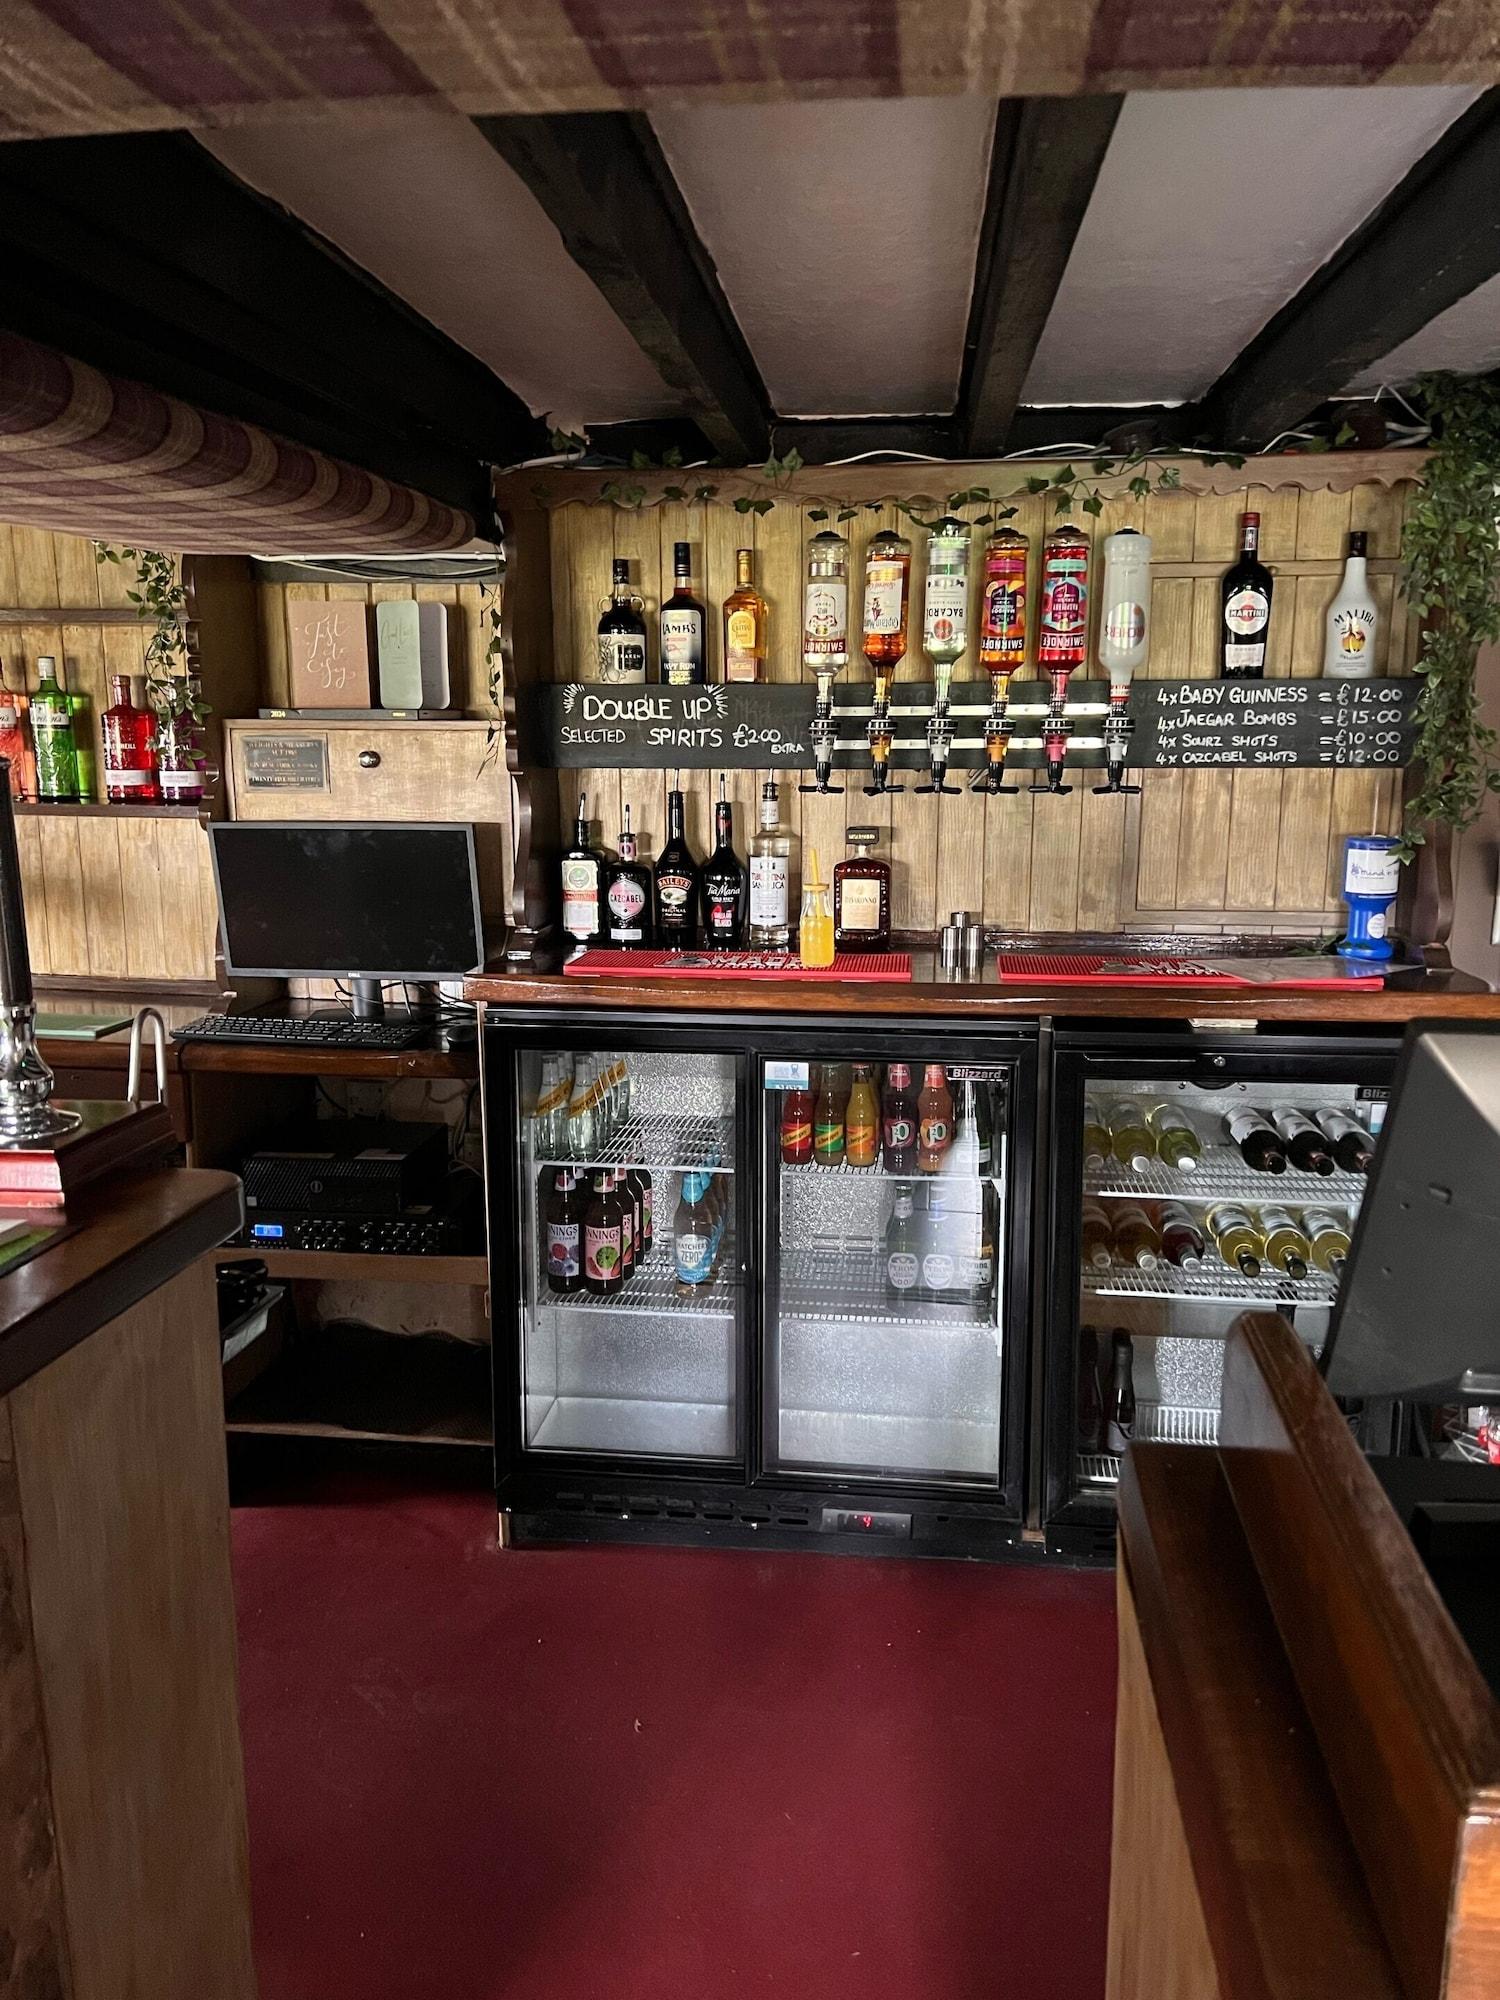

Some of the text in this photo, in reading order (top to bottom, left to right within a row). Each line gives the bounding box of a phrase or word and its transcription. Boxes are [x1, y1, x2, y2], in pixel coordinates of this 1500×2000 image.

[1229, 608, 1266, 618] MARTINI
[1334, 609, 1376, 628] MALIBU
[982, 638, 1023, 650] SMIRNOFF
[1043, 634, 1085, 647] SMIRNOFF
[1179, 685, 1226, 705] BABY
[1228, 687, 1308, 704] GUINNESS
[582, 694, 713, 721] DOUBLE UP
[1175, 709, 1235, 727] JAEGAR
[1241, 710, 1297, 726] BOMBS
[560, 726, 626, 744] SELECTED
[646, 728, 723, 748] SPIRITS
[1232, 734, 1278, 747] SHOTS
[1182, 750, 1247, 763] CAZCABEL
[1253, 750, 1298, 763] SHOTS
[657, 877, 690, 888] BAILEYS
[705, 883, 741, 897] Tia Maria
[610, 894, 643, 903] CAZCABEL
[951, 1068, 1001, 1079] Blizzard
